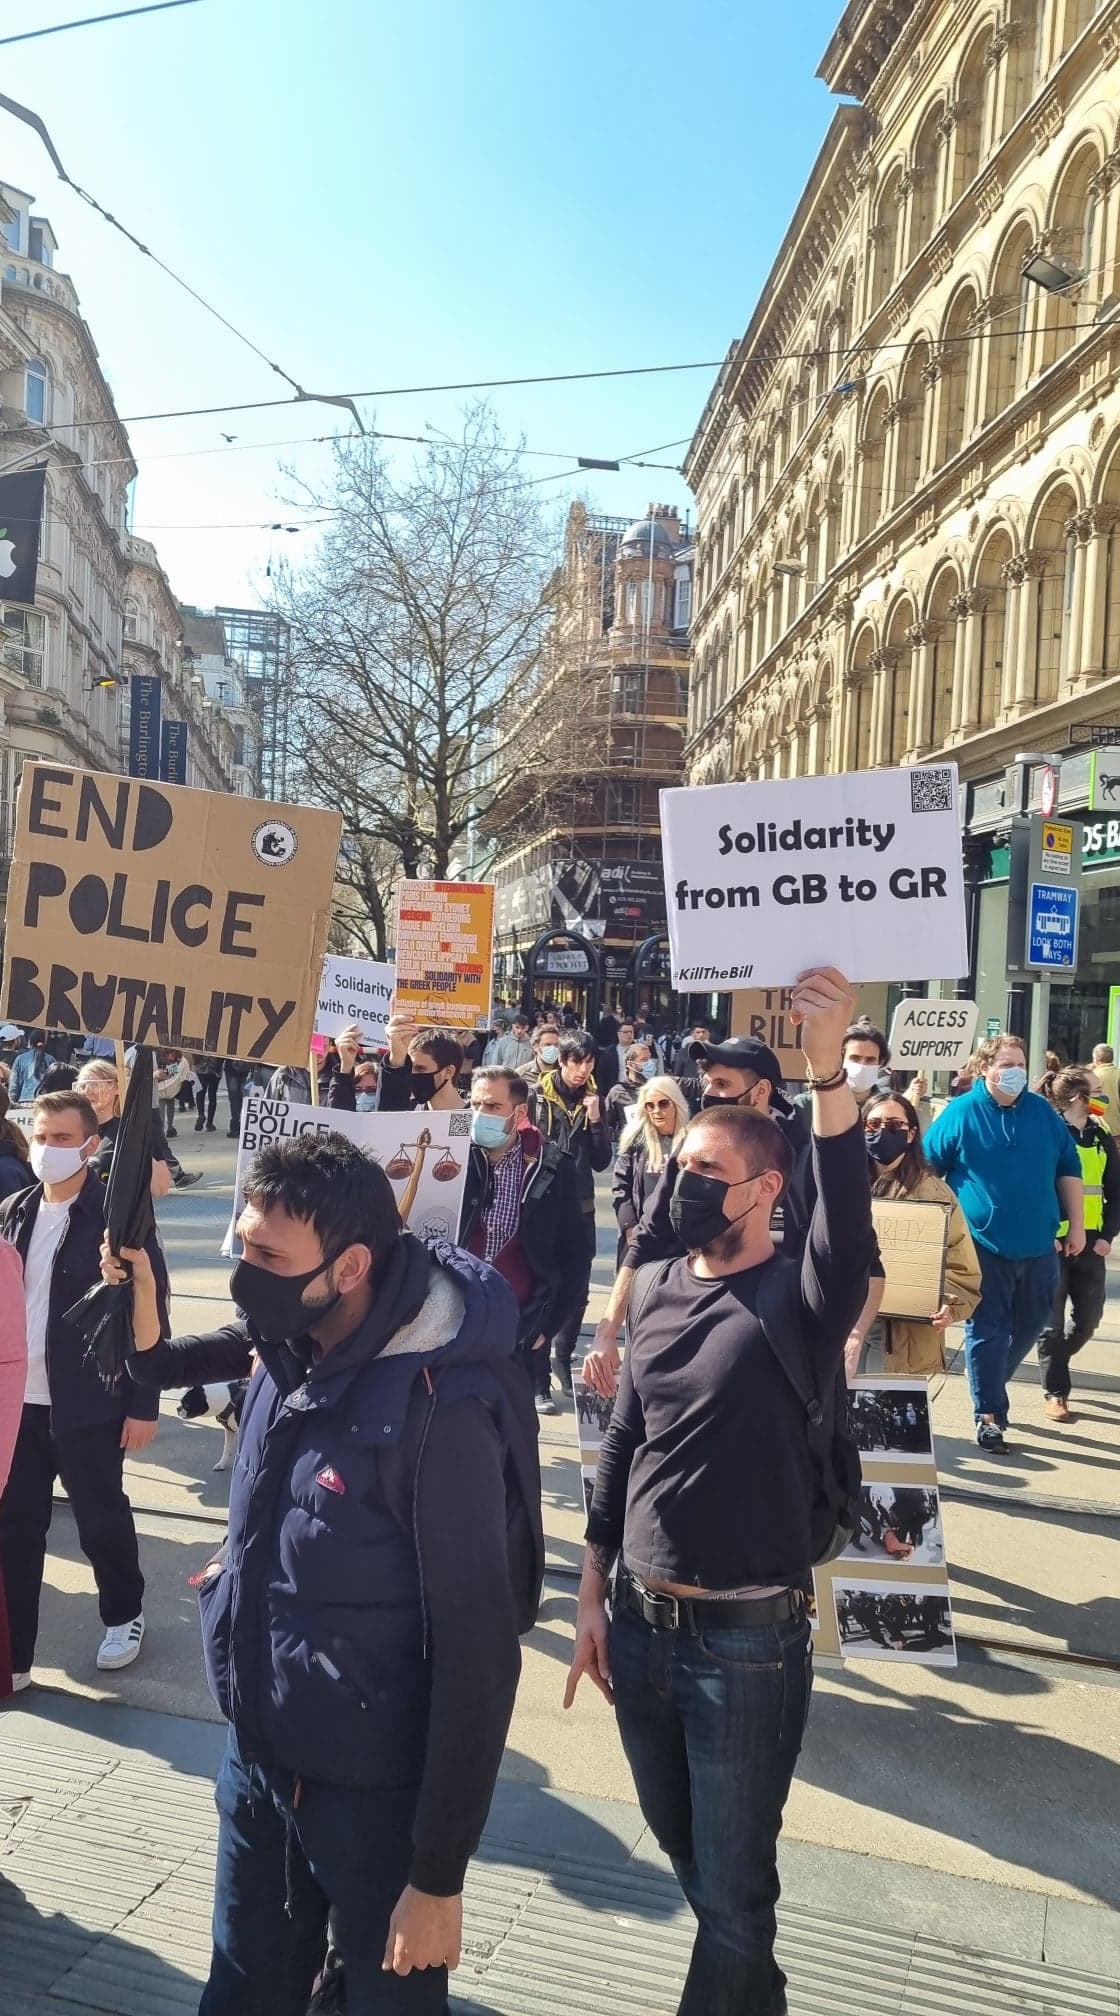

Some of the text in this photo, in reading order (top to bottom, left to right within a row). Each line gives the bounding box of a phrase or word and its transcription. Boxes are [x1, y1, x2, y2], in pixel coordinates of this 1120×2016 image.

[141, 680, 152, 706] The
[169, 725, 180, 746] The
[28, 767, 173, 851] END
[718, 817, 896, 856] Solidarity
[676, 866, 947, 910] from GB to GR
[1038, 890, 1073, 903] TRAMWAY
[24, 861, 265, 958] POLICE
[1053, 939, 1072, 949] BOTH
[425, 971, 462, 982] SOLIDARITY
[463, 974, 481, 984] WITH
[673, 965, 753, 980] #KillTheBill
[334, 974, 393, 1001] Solidarity
[410, 979, 430, 990] GREEK
[432, 981, 456, 992] PEOPLE
[6, 956, 297, 1058] BRUTALITY
[318, 999, 344, 1015] with
[347, 1004, 391, 1025] Greece
[904, 1010, 969, 1028] ACCESS
[900, 1040, 962, 1057] SUPPORT
[247, 1099, 289, 1117] END
[245, 1113, 330, 1138] POLICE
[243, 1132, 280, 1151] BR
